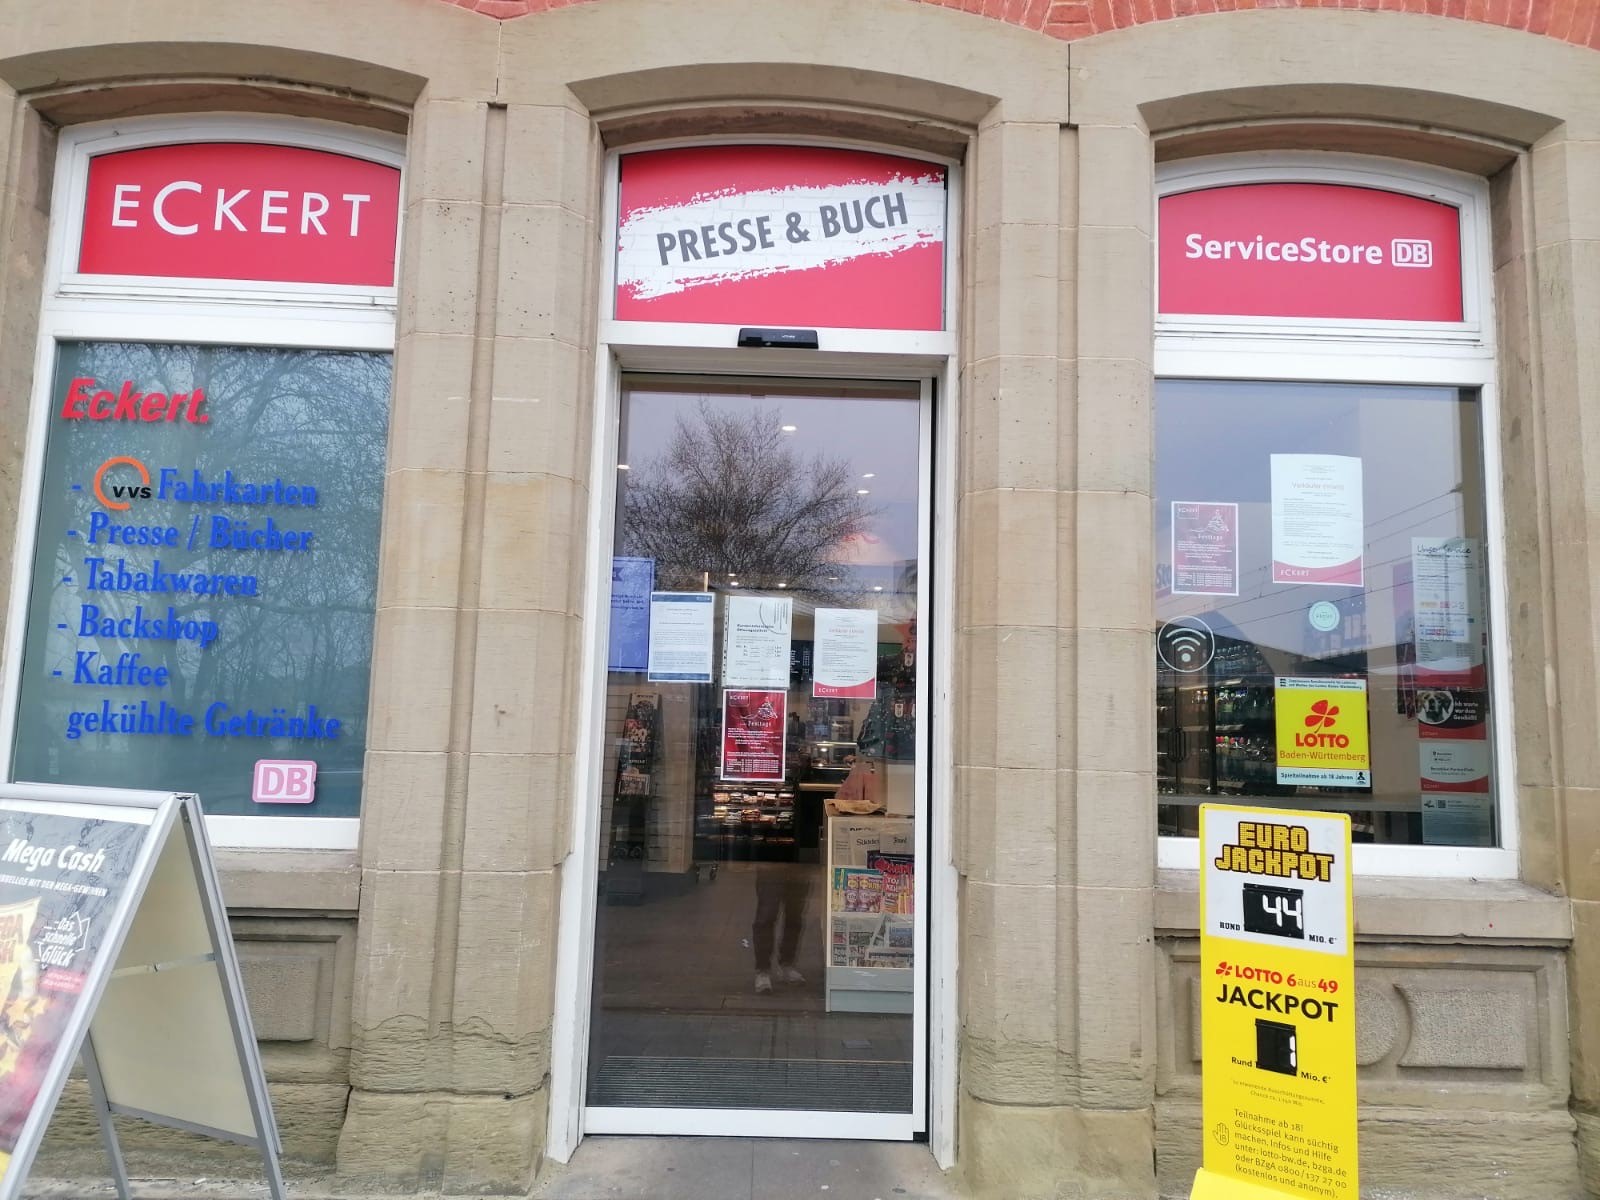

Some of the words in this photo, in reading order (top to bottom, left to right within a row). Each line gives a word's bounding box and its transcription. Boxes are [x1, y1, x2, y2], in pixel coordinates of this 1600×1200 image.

[111, 180, 371, 236] ECKERT
[656, 215, 774, 266] PRESSE
[785, 212, 810, 243] &
[819, 192, 909, 239] BUCH
[1185, 233, 1383, 265] ServiceStore
[1394, 241, 1430, 265] DB
[61, 377, 210, 424] Eckert.
[157, 468, 317, 505] Fahrkarten
[88, 512, 179, 547] Presse
[209, 515, 313, 550] Bücher
[84, 558, 257, 596] Tabakwaren
[78, 604, 218, 648] Backshop
[73, 652, 169, 687] Kaffee
[66, 700, 194, 739] gekühlte
[205, 702, 341, 739] Getränke
[1279, 751, 1366, 763] Baden-Württemberg
[1295, 733, 1350, 748] LOTTO
[258, 764, 311, 799] DB
[1238, 821, 1310, 853] EURO
[1, 838, 57, 872] Mega
[57, 845, 106, 873] Cash
[1214, 844, 1335, 882] JACKPOT
[1262, 894, 1303, 930] 44
[41, 945, 76, 968] Glück
[1235, 965, 1283, 985] LOTTO
[1216, 983, 1339, 1023] JACKPOT
[1231, 1056, 1253, 1068] Rund
[1301, 1071, 1321, 1083] Mio.
[1234, 1108, 1276, 1126] Teilnahme
[1278, 1120, 1289, 1129] ab
[1234, 1120, 1281, 1138] Glücksspiel
[1284, 1132, 1304, 1144] kann
[1307, 1138, 1339, 1153] süchtig
[1234, 1132, 1269, 1146] machen.
[1270, 1140, 1291, 1152] Infos
[1293, 1144, 1310, 1156] und
[1311, 1151, 1332, 1162] Hilfe
[1234, 1143, 1260, 1155] unter:
[1260, 1147, 1311, 1169] lotto-bw.de,
[1312, 1162, 1347, 1177] bzga.de
[1235, 1154, 1254, 1165] oder
[1255, 1159, 1276, 1171] BZgA
[1278, 1165, 1300, 1177] 0800
[1306, 1172, 1320, 1183] 137
[1322, 1176, 1333, 1186] 27
[1335, 1180, 1347, 1189] 00
[1235, 1164, 1279, 1182] (kostenlos
[1279, 1174, 1296, 1187] und
[1297, 1180, 1339, 1198] anonym).
